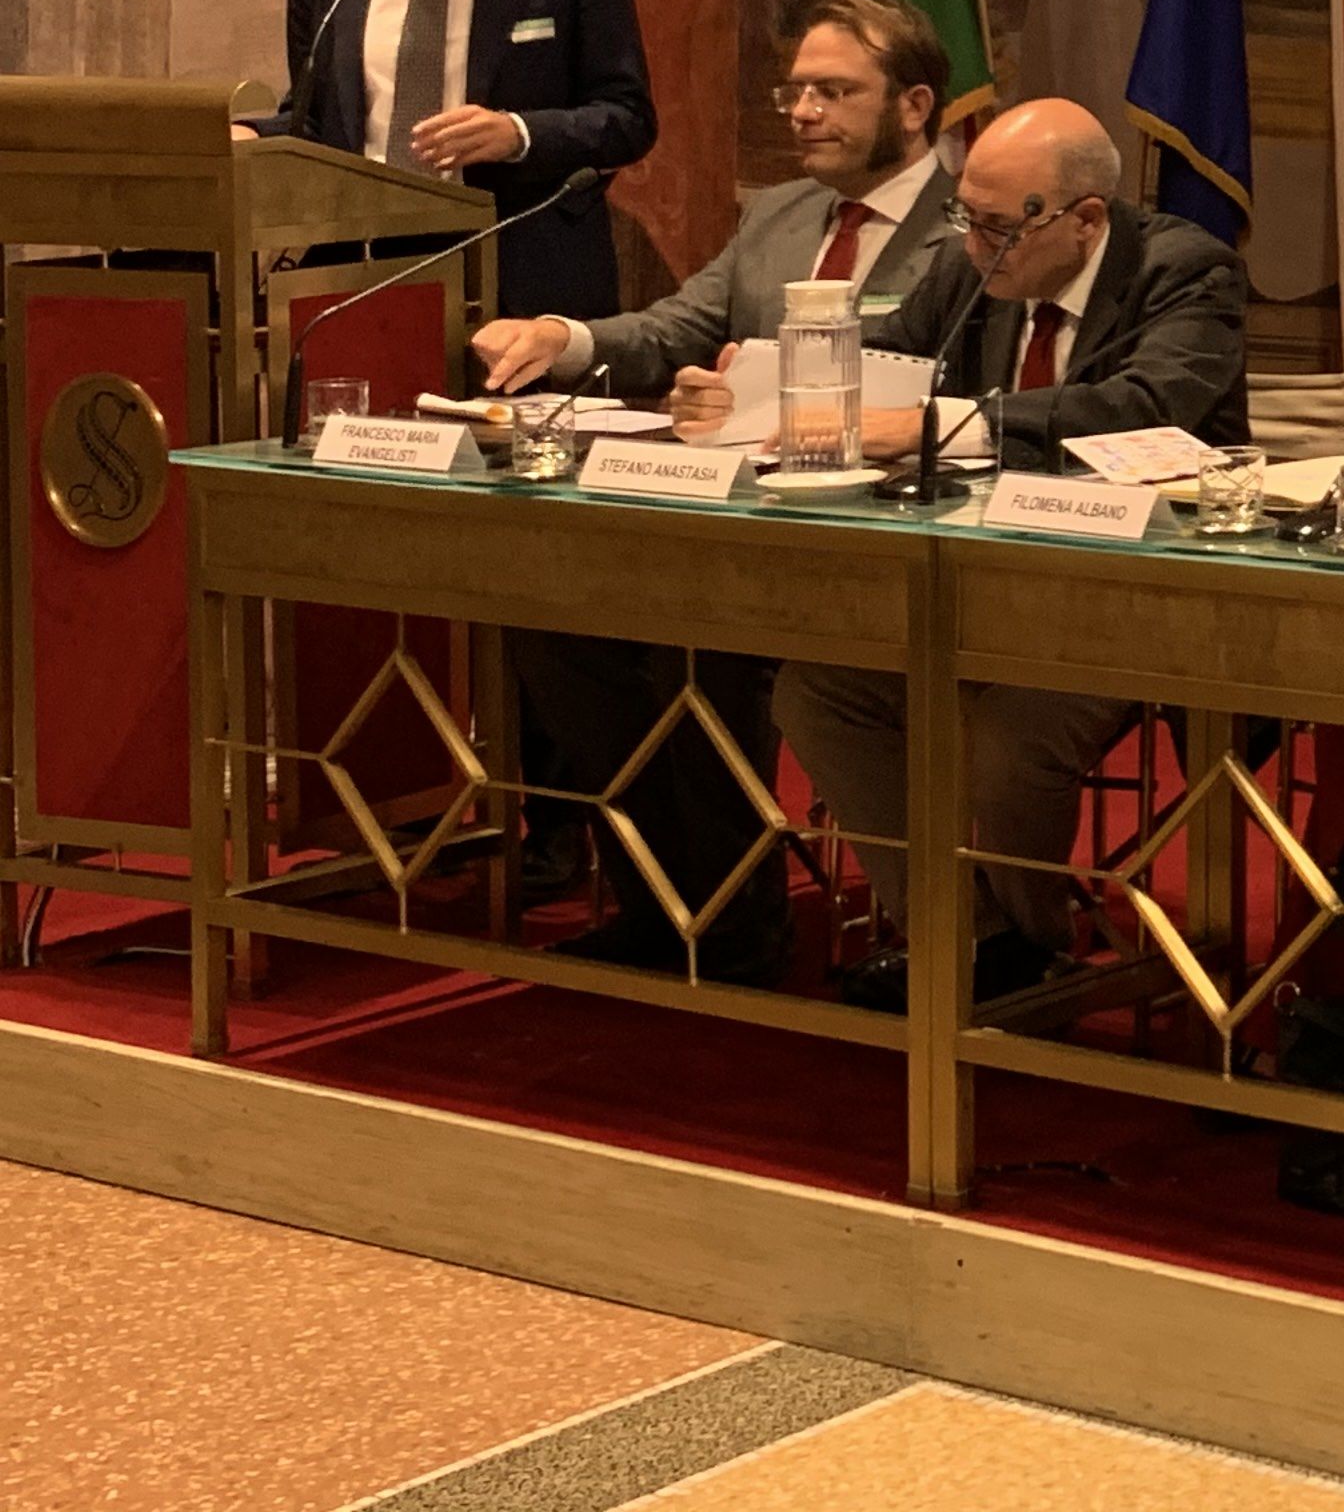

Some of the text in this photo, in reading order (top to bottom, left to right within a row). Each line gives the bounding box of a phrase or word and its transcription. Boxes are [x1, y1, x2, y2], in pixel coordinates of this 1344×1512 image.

[341, 424, 441, 446] FRANCESCO MARIA
[348, 445, 418, 464] EVANGELISTI
[598, 458, 719, 482] STEFANO ANASTASIA
[1011, 494, 1128, 520] FILOMENA ALBANO
